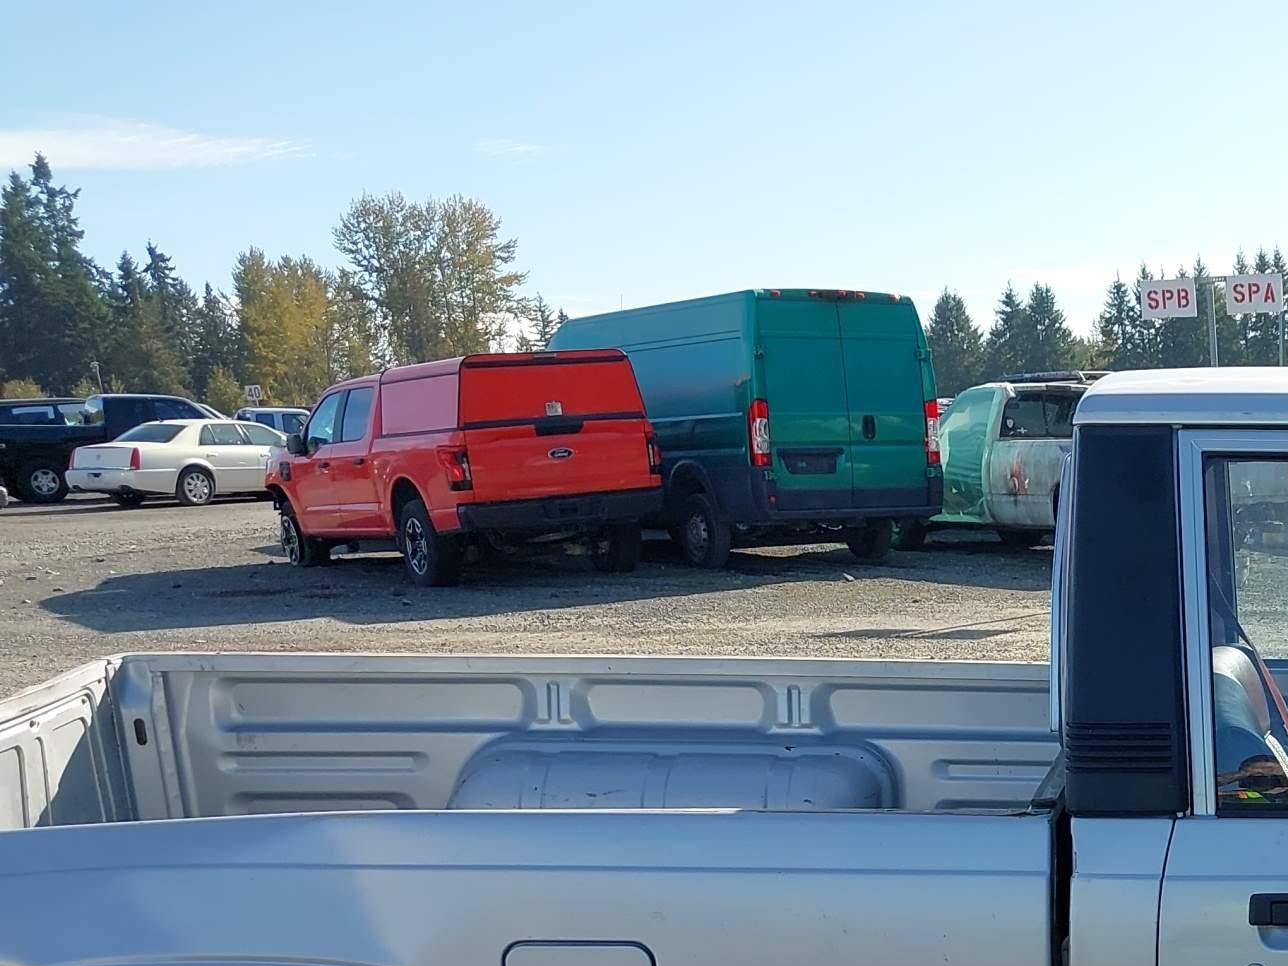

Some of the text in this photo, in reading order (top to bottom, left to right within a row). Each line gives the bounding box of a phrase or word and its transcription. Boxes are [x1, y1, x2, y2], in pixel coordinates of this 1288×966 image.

[1146, 288, 1190, 310] SPB
[1232, 282, 1276, 304] SPA
[247, 386, 261, 399] 40
